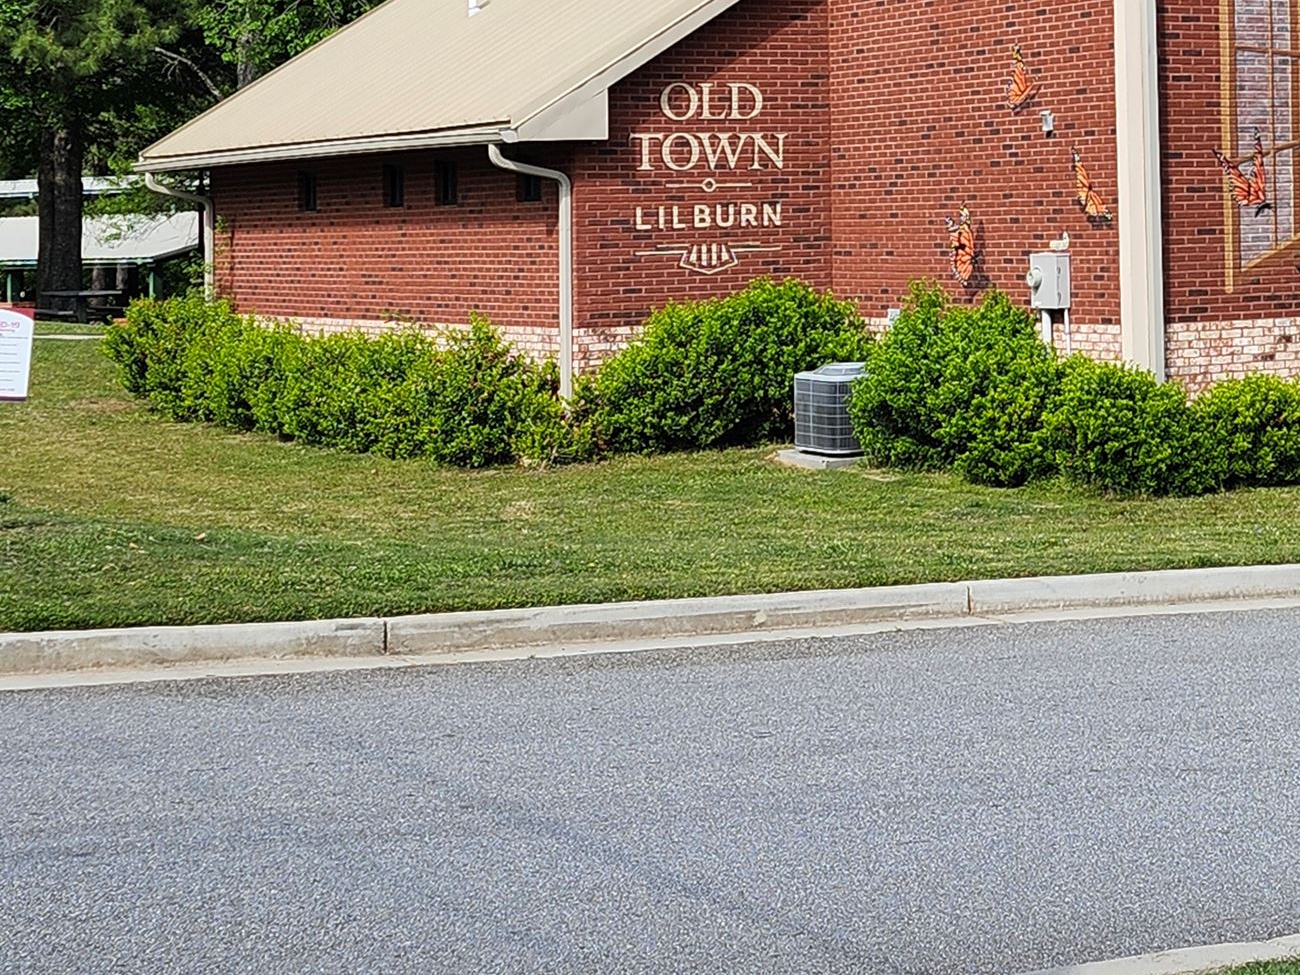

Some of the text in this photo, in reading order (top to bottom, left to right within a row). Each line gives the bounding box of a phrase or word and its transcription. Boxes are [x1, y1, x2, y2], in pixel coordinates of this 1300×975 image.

[660, 82, 763, 120] OLD
[629, 132, 788, 170] TOWN
[635, 203, 782, 230] LILBURN
